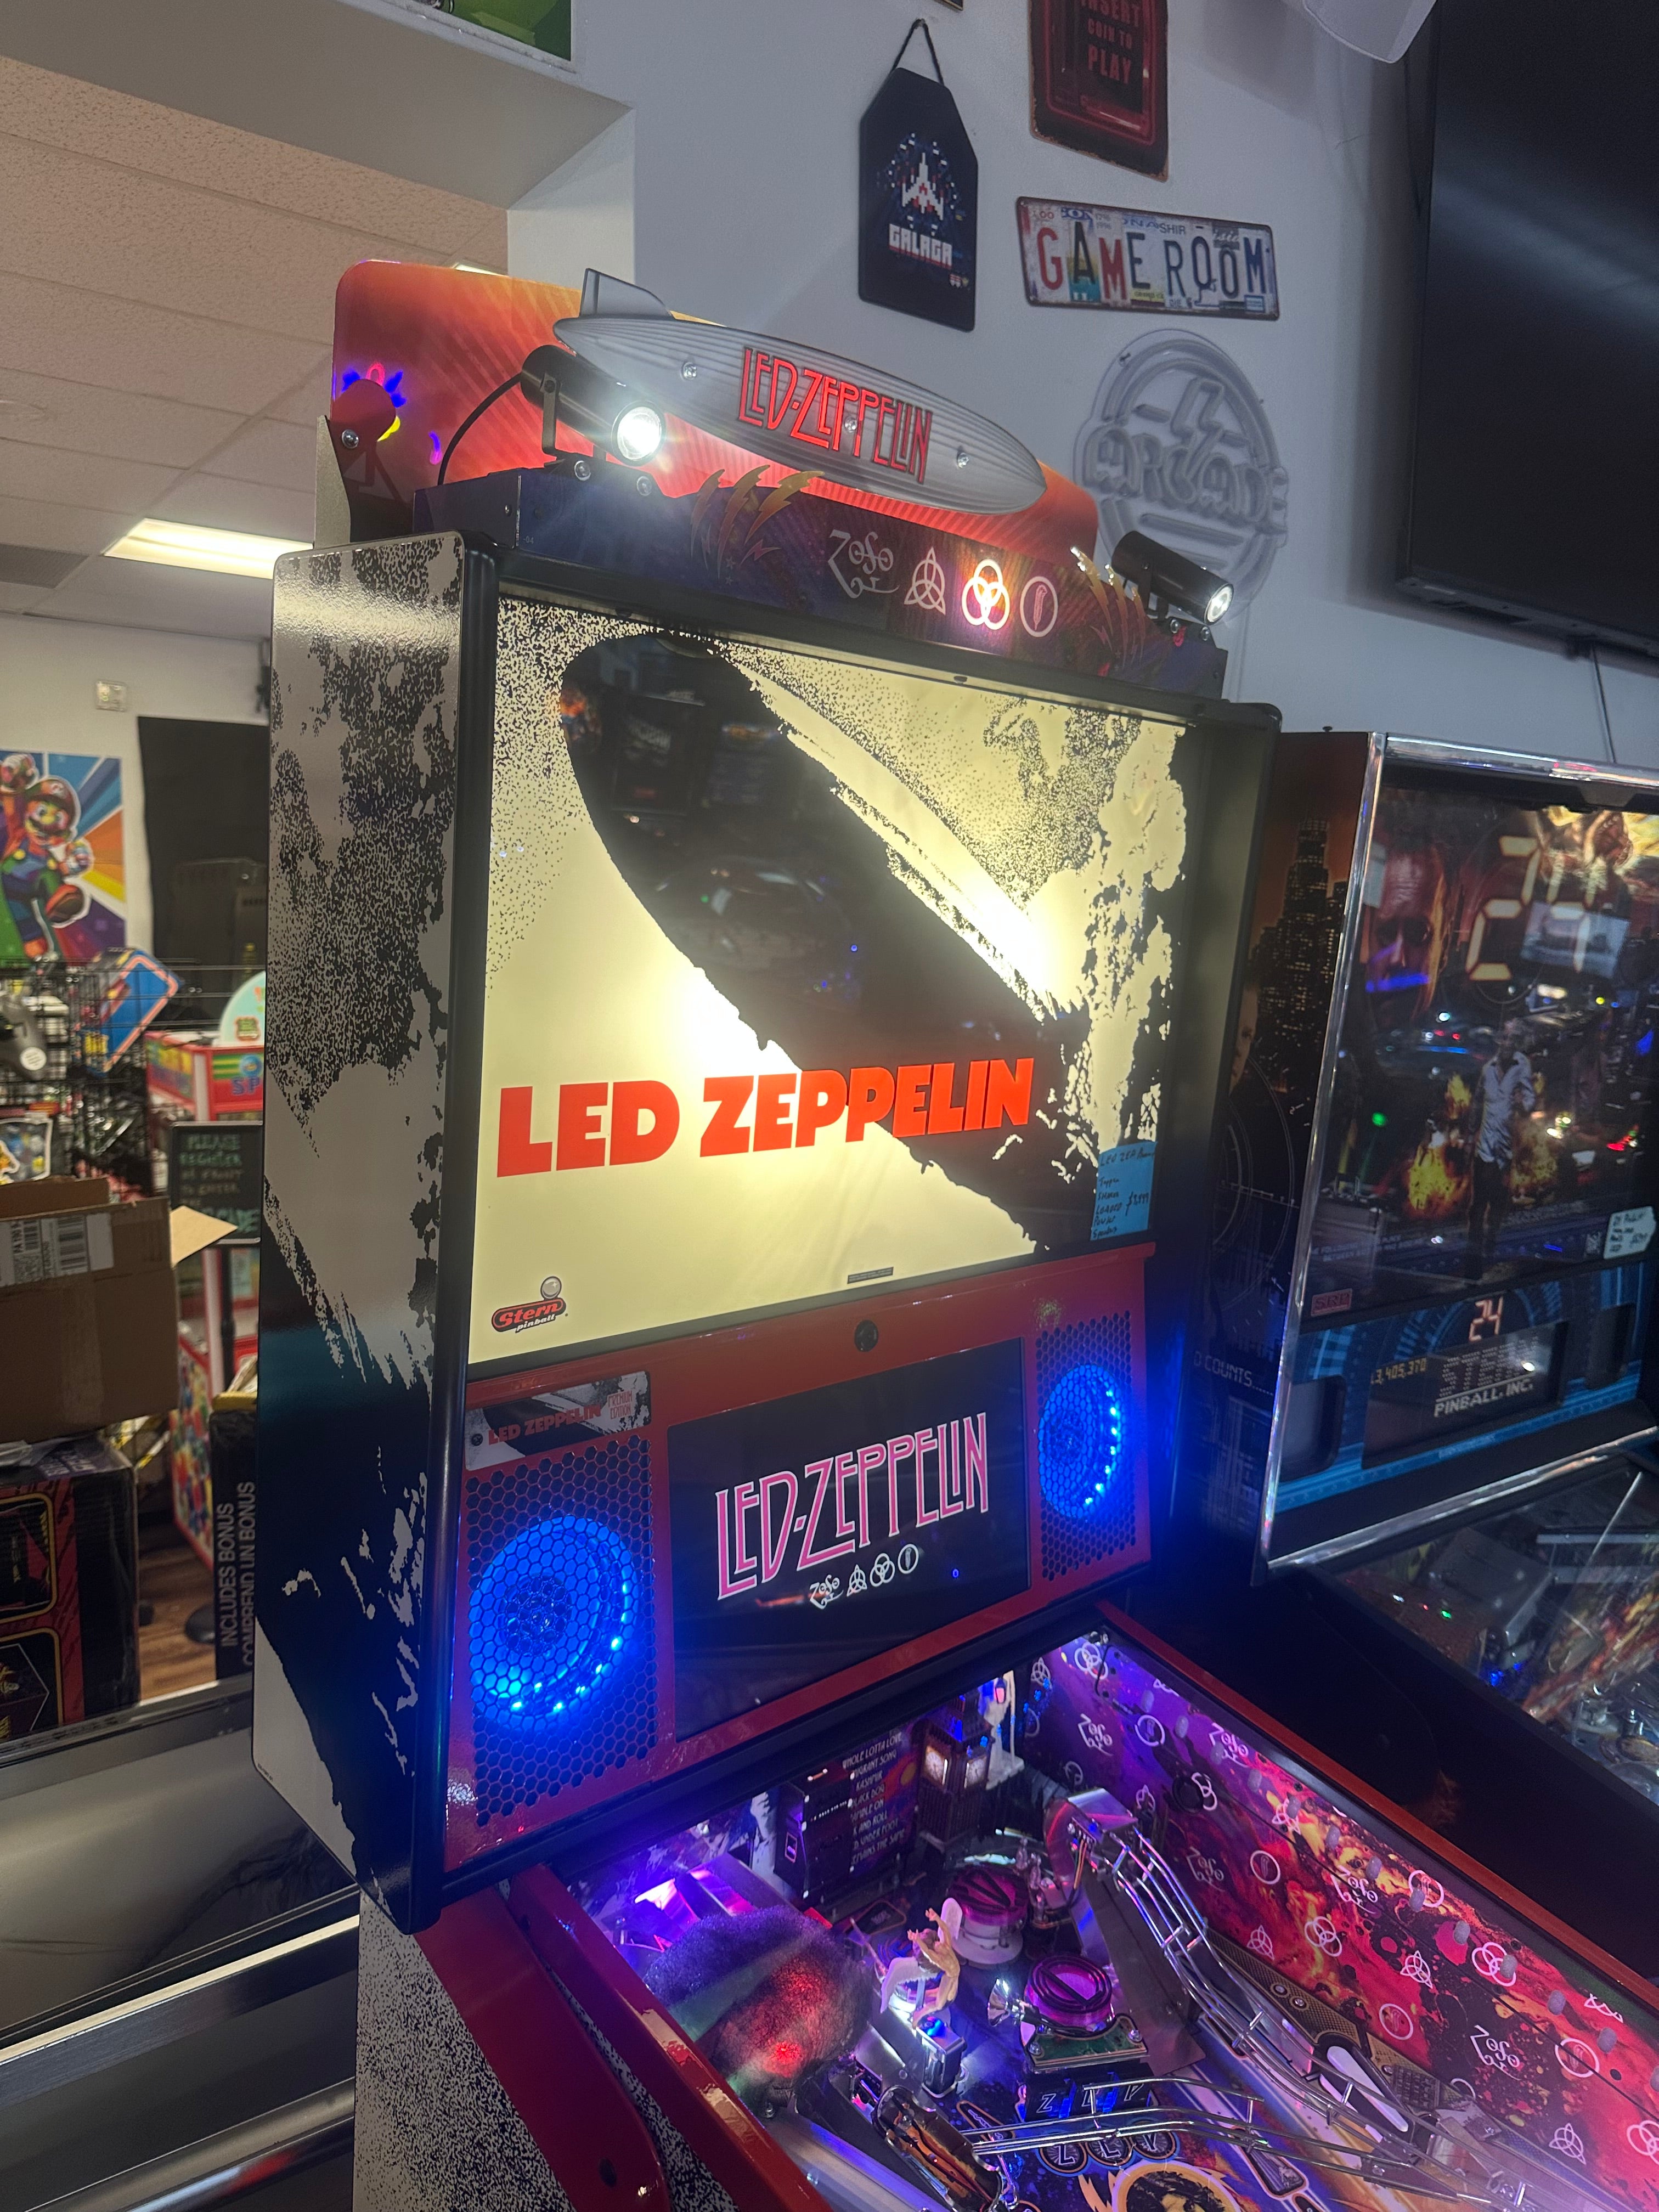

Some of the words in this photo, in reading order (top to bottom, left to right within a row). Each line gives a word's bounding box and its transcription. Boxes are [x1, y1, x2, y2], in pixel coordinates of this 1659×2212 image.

[1088, 18, 1115, 42] COIN
[1120, 30, 1132, 49] TO
[1088, 44, 1131, 83] PLAY
[889, 223, 952, 269] GALAGA
[1037, 221, 1150, 300] GAME
[1164, 236, 1266, 299] ROOM
[496, 1080, 680, 1178] LED
[699, 1057, 1034, 1158] ZEPPELIN
[499, 1302, 558, 1327] Stern
[512, 1314, 556, 1332] pinball
[1468, 1295, 1504, 1342] 24
[488, 1424, 521, 1445] LED
[524, 1404, 601, 1436] ZEPPELIN
[216, 1502, 235, 1562] BONUS
[236, 1481, 256, 1541] BONUS
[239, 1544, 256, 1570] UN
[219, 1565, 239, 1646] INCLUDES
